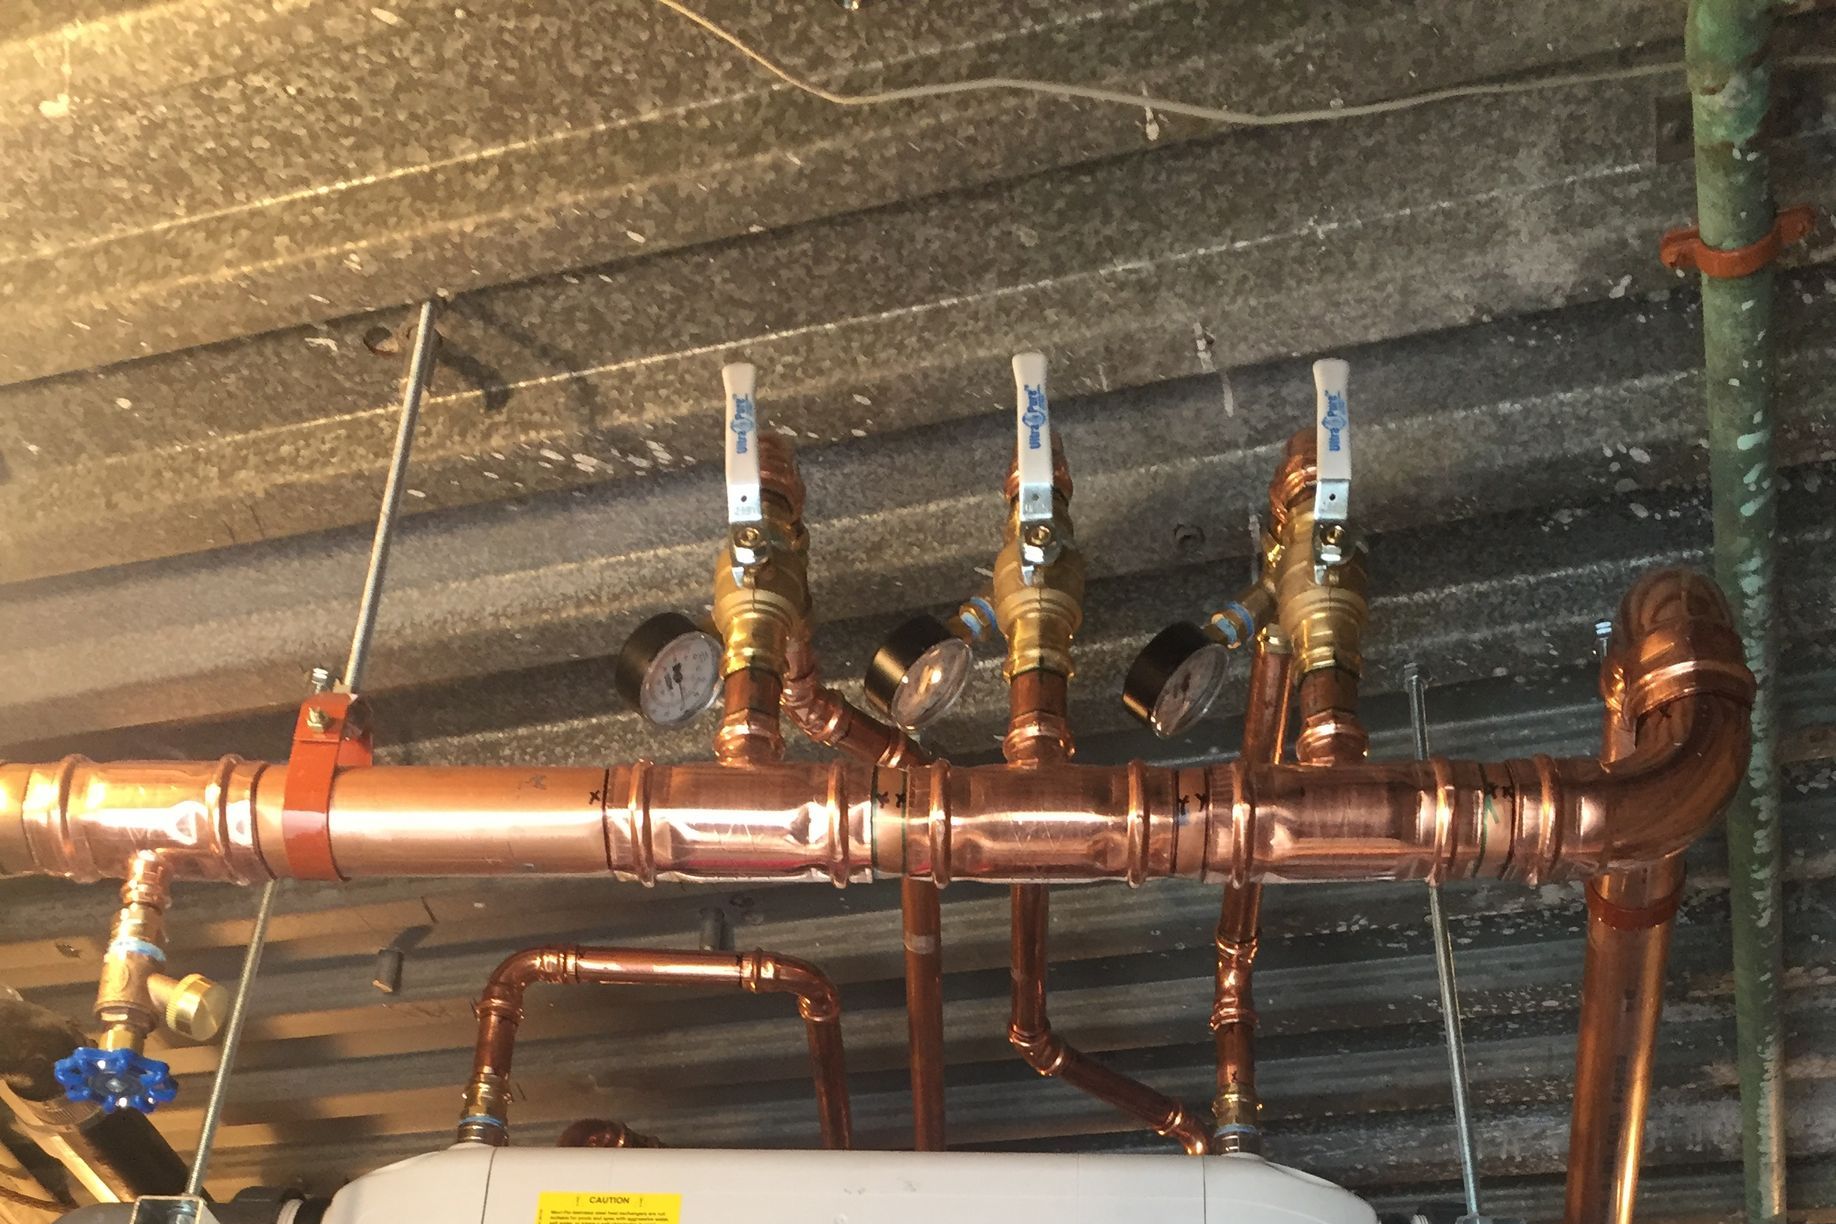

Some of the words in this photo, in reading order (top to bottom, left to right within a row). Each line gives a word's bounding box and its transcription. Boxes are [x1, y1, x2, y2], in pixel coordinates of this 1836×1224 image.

[735, 398, 746, 420] Pure
[1027, 390, 1038, 413] Pure
[1327, 395, 1338, 417] Pure
[735, 431, 747, 454] Ultra
[1029, 424, 1041, 450] Ultra
[1328, 427, 1341, 451] Ultra
[589, 1196, 630, 1205] CAUTION
